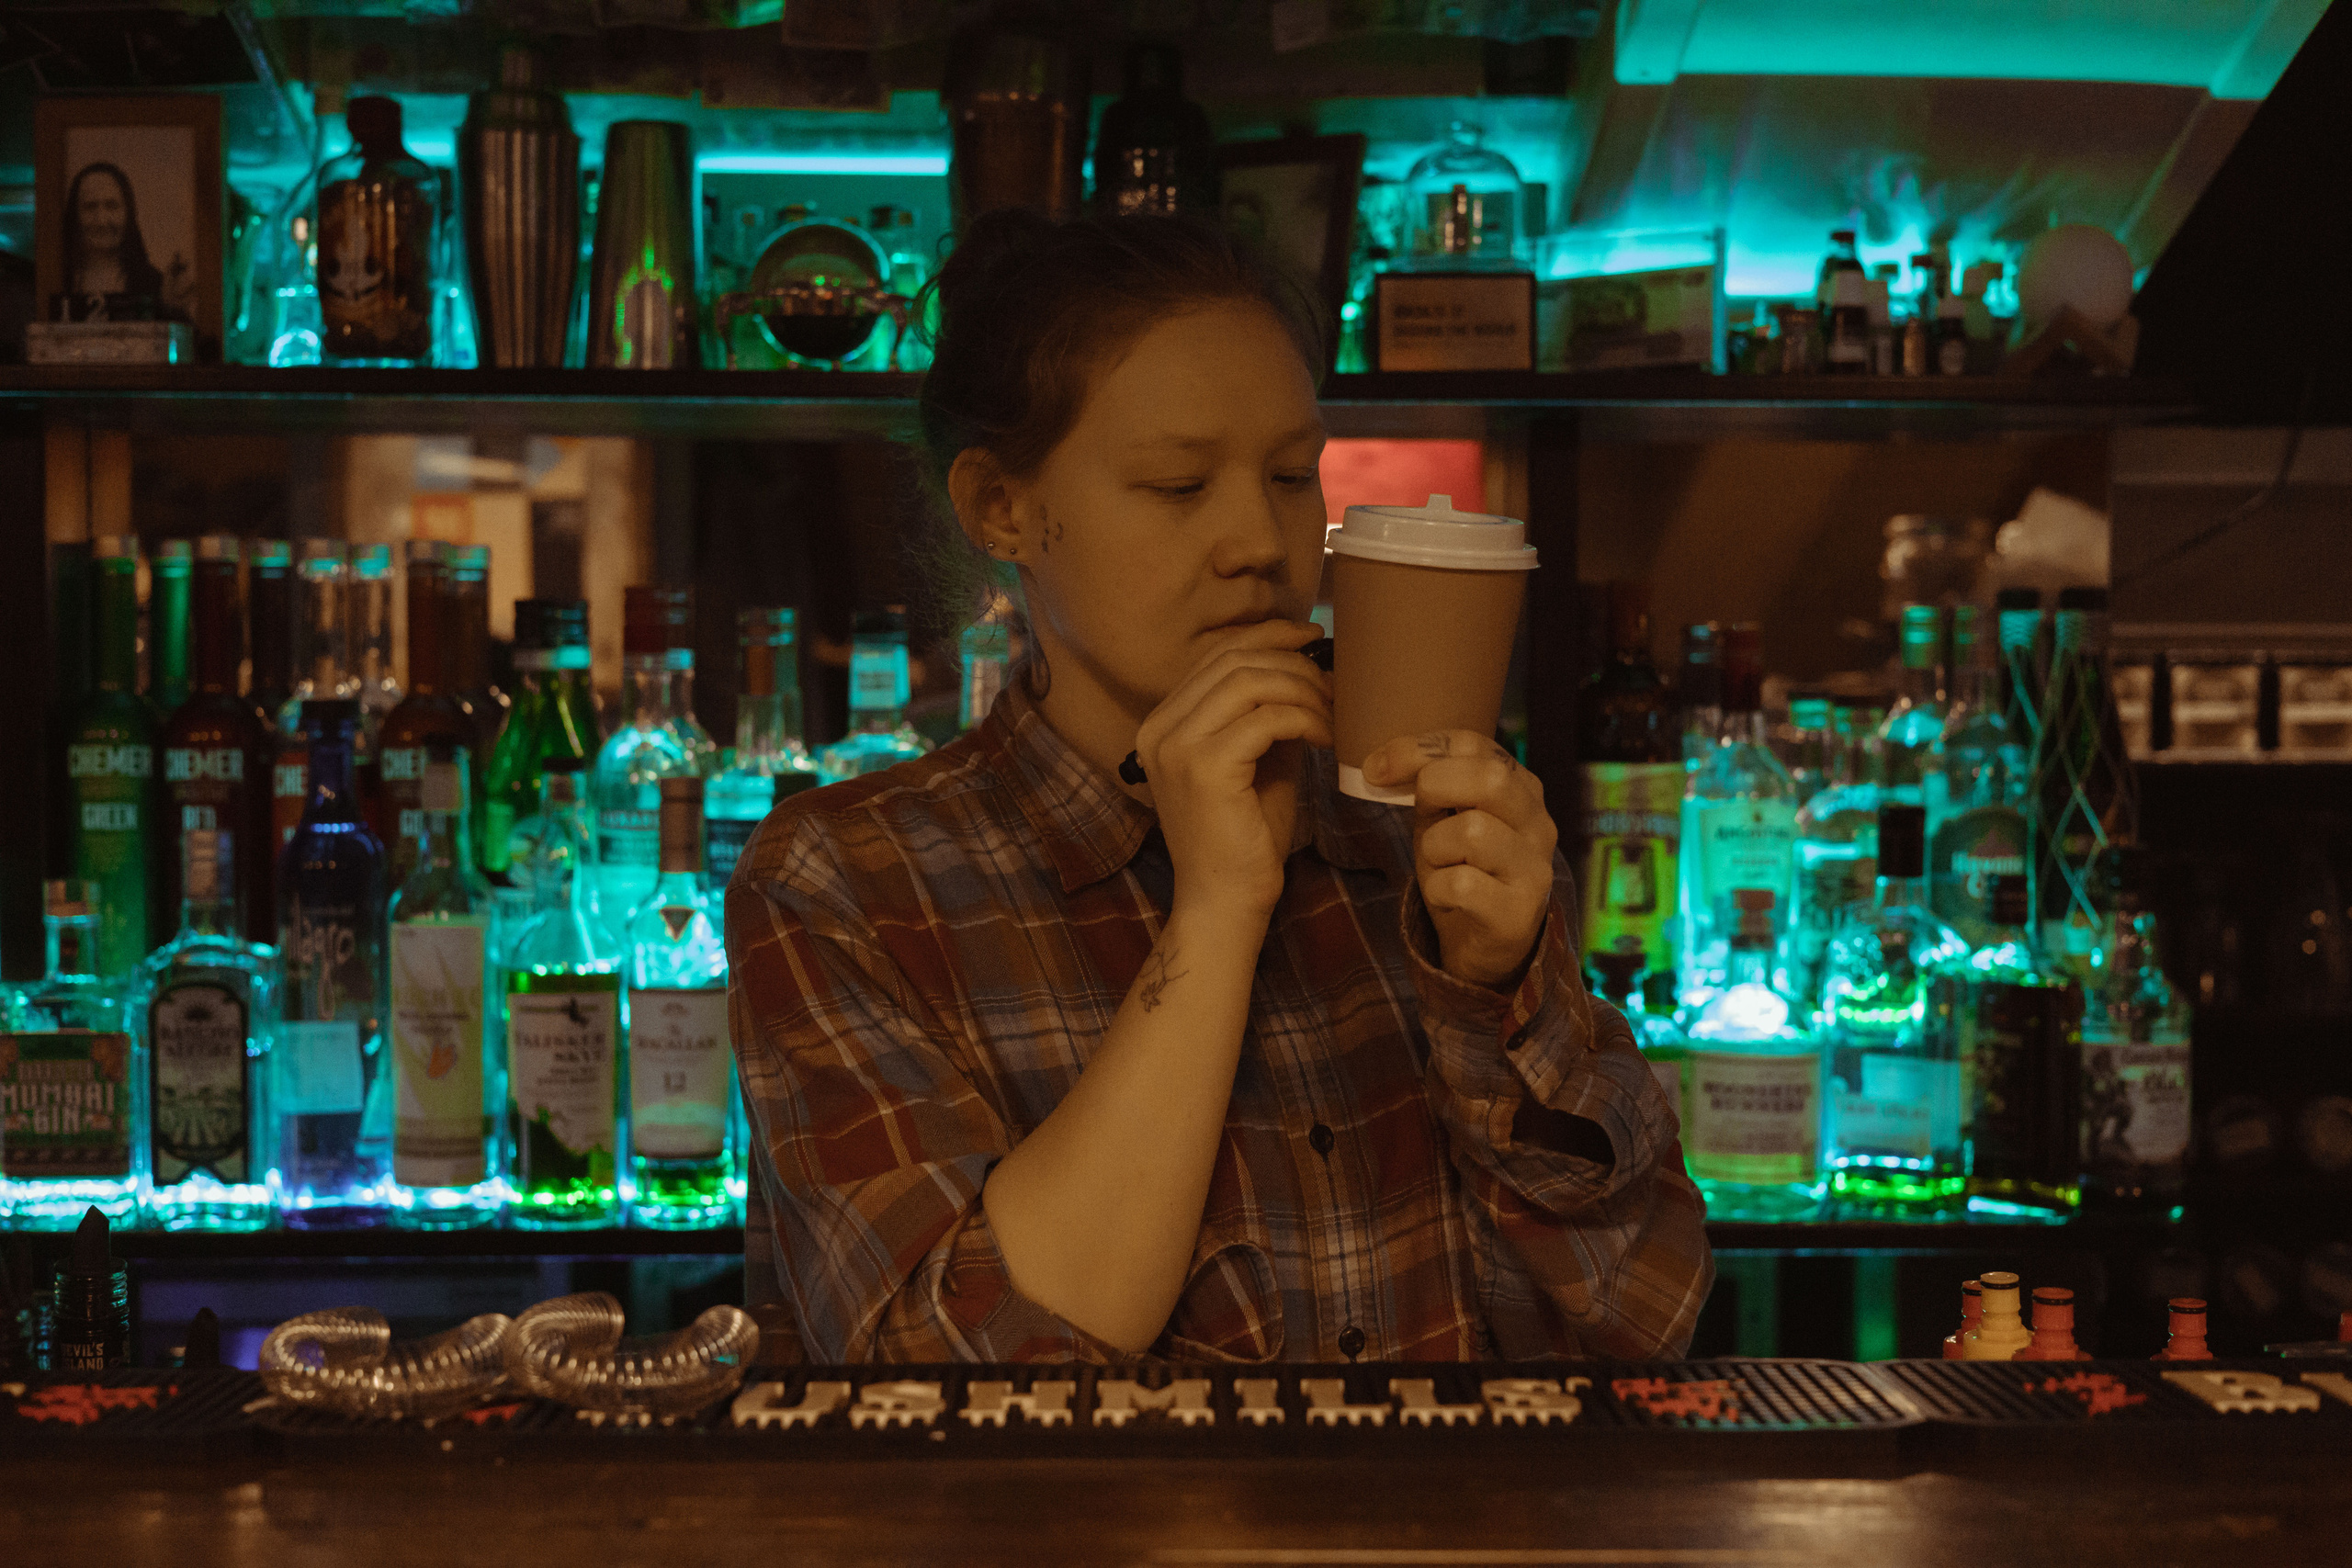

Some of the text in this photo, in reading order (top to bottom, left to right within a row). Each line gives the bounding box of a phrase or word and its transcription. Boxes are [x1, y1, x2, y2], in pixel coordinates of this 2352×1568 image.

[274, 764, 308, 797] CHE
[0, 1083, 115, 1113] MUMBAI
[33, 1107, 81, 1134] GIN
[65, 1358, 105, 1371] SLAND
[575, 1378, 1582, 1429] USHMILLS
